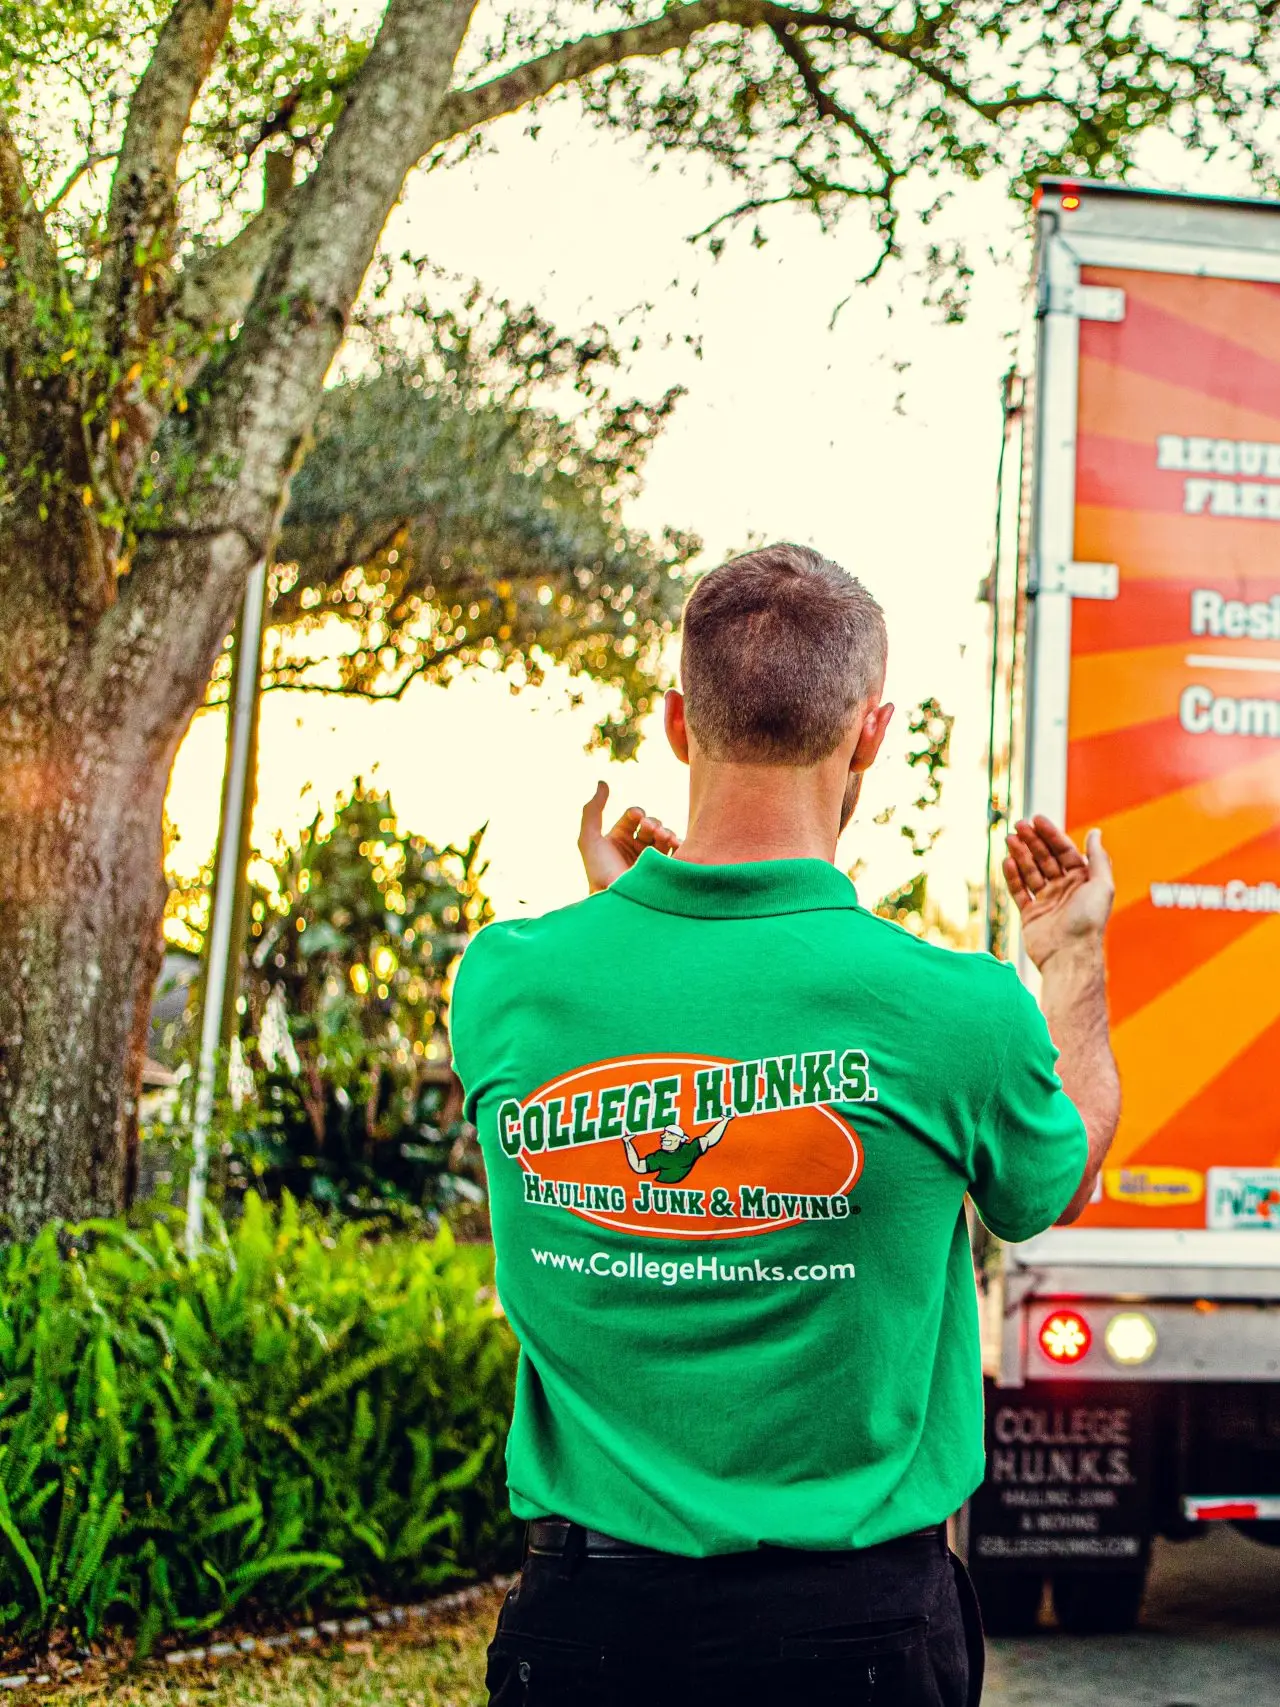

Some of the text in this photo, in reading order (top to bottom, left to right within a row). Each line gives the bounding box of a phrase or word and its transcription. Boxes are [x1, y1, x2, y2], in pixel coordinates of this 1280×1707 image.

[499, 1049, 878, 1158] COLLEGE H.U.N.K.S.
[522, 1173, 850, 1220] HAULING JUNK & MOVING
[531, 1248, 855, 1285] www.CollegeHunks.com
[994, 1407, 1132, 1444] COLLEGE
